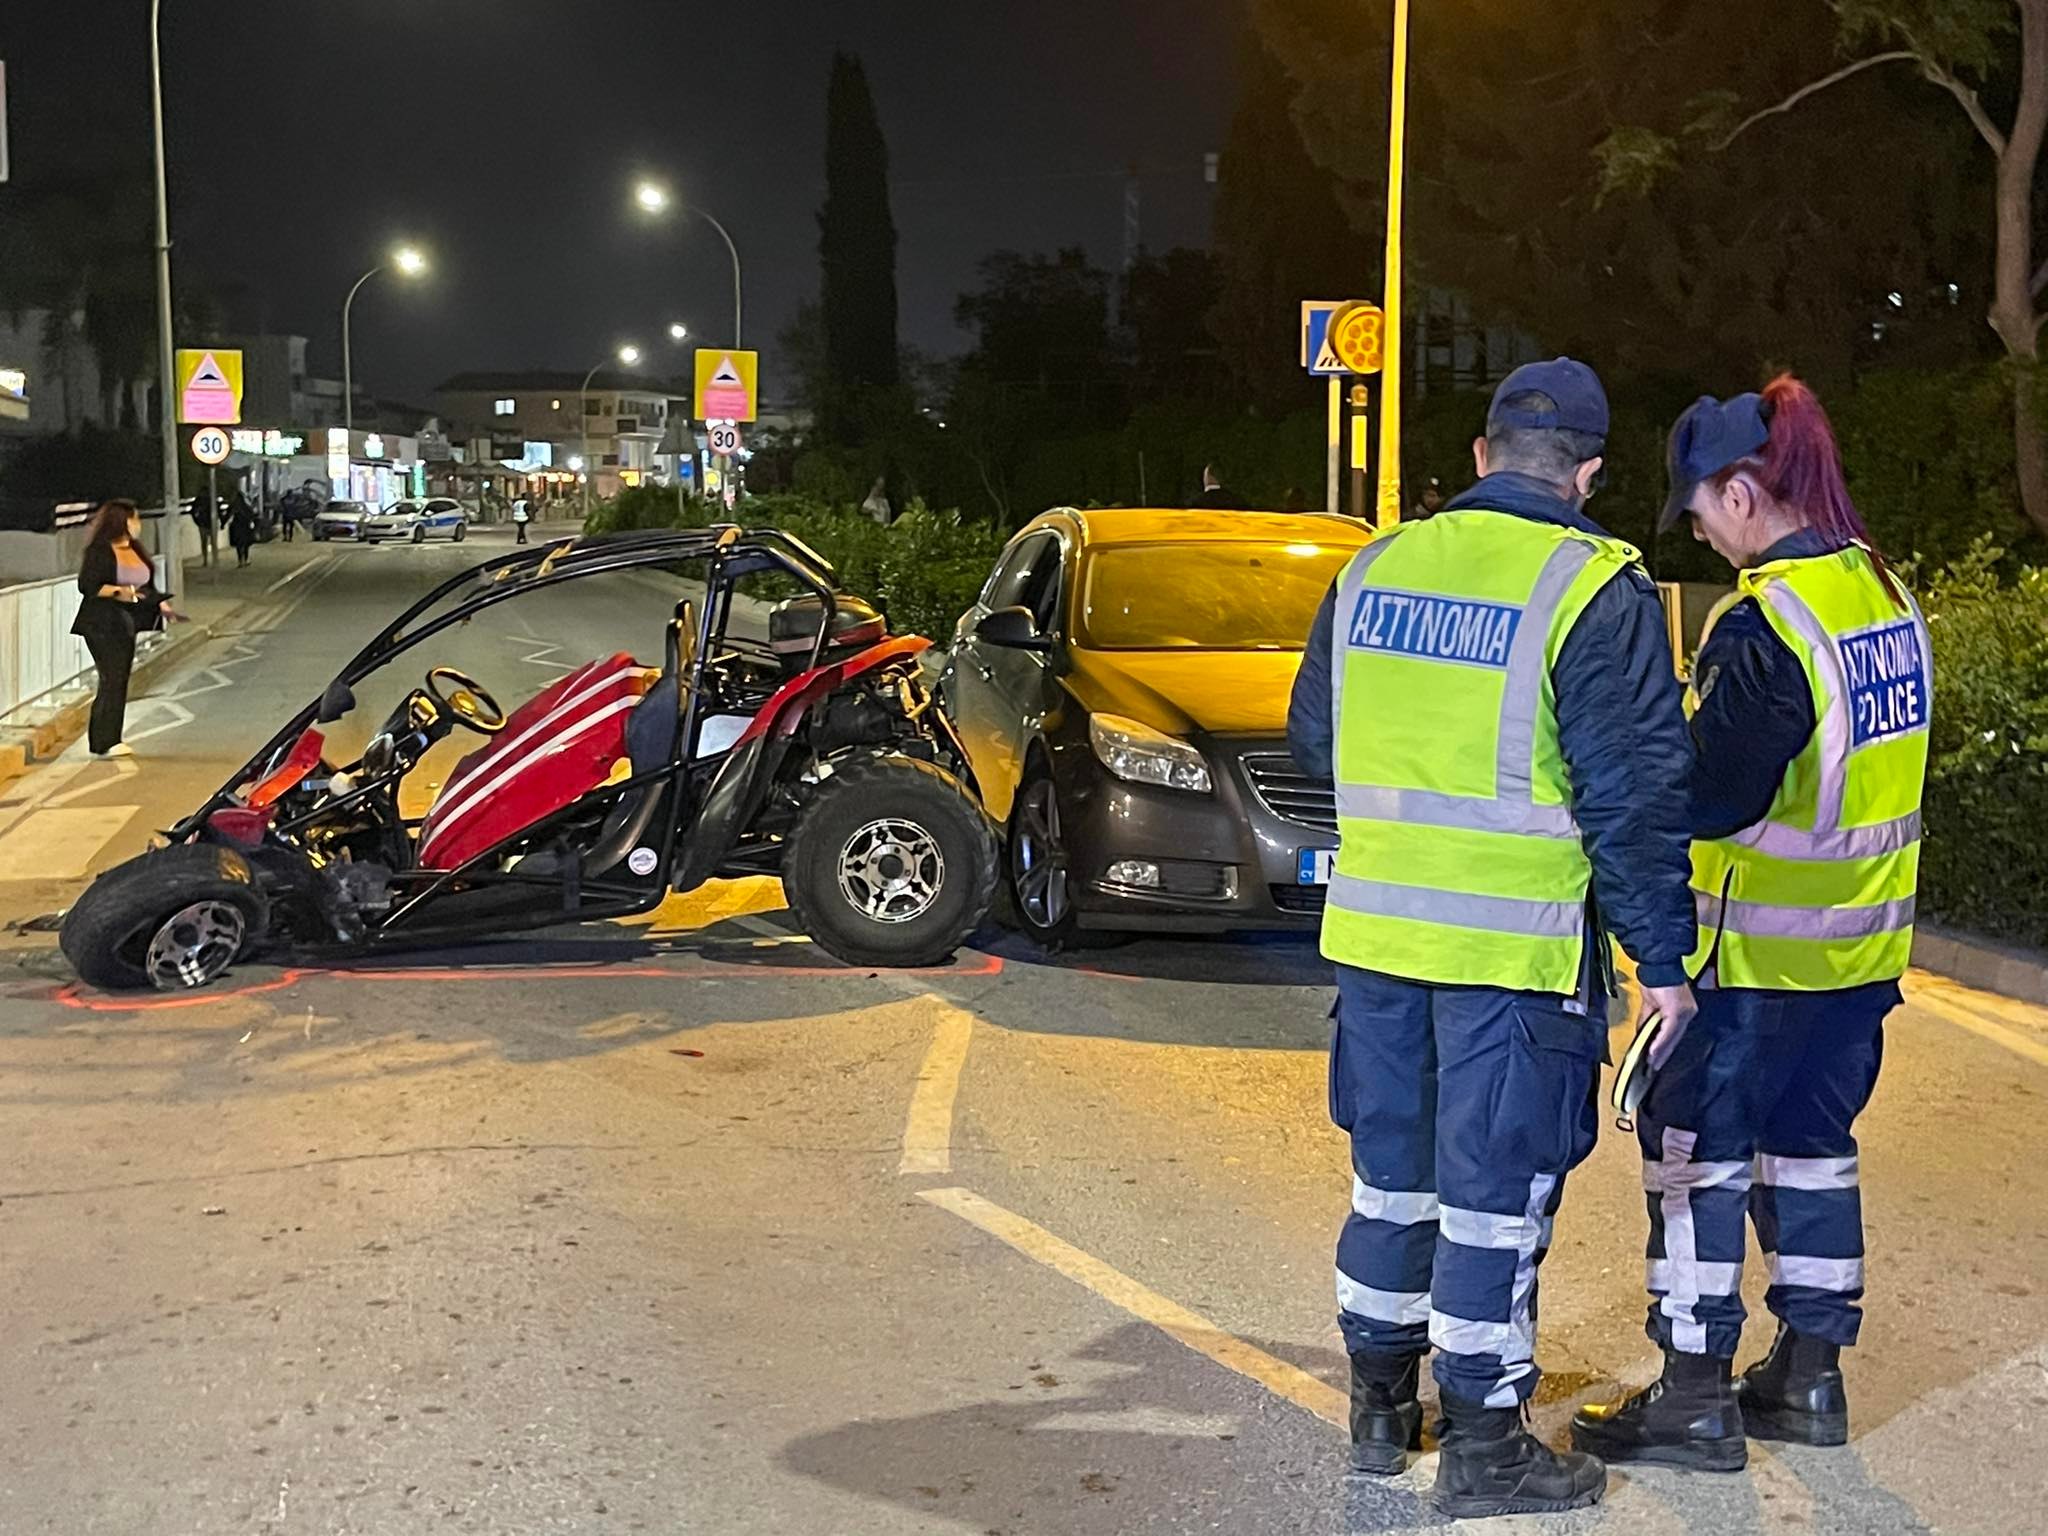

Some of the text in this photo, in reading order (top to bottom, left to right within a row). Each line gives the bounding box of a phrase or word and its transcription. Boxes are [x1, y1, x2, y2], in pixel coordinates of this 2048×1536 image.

[200, 437, 222, 453] 30
[714, 431, 735, 448] 30
[1351, 593, 1512, 663] ΑΣΤΥΝΟΜΙΑ
